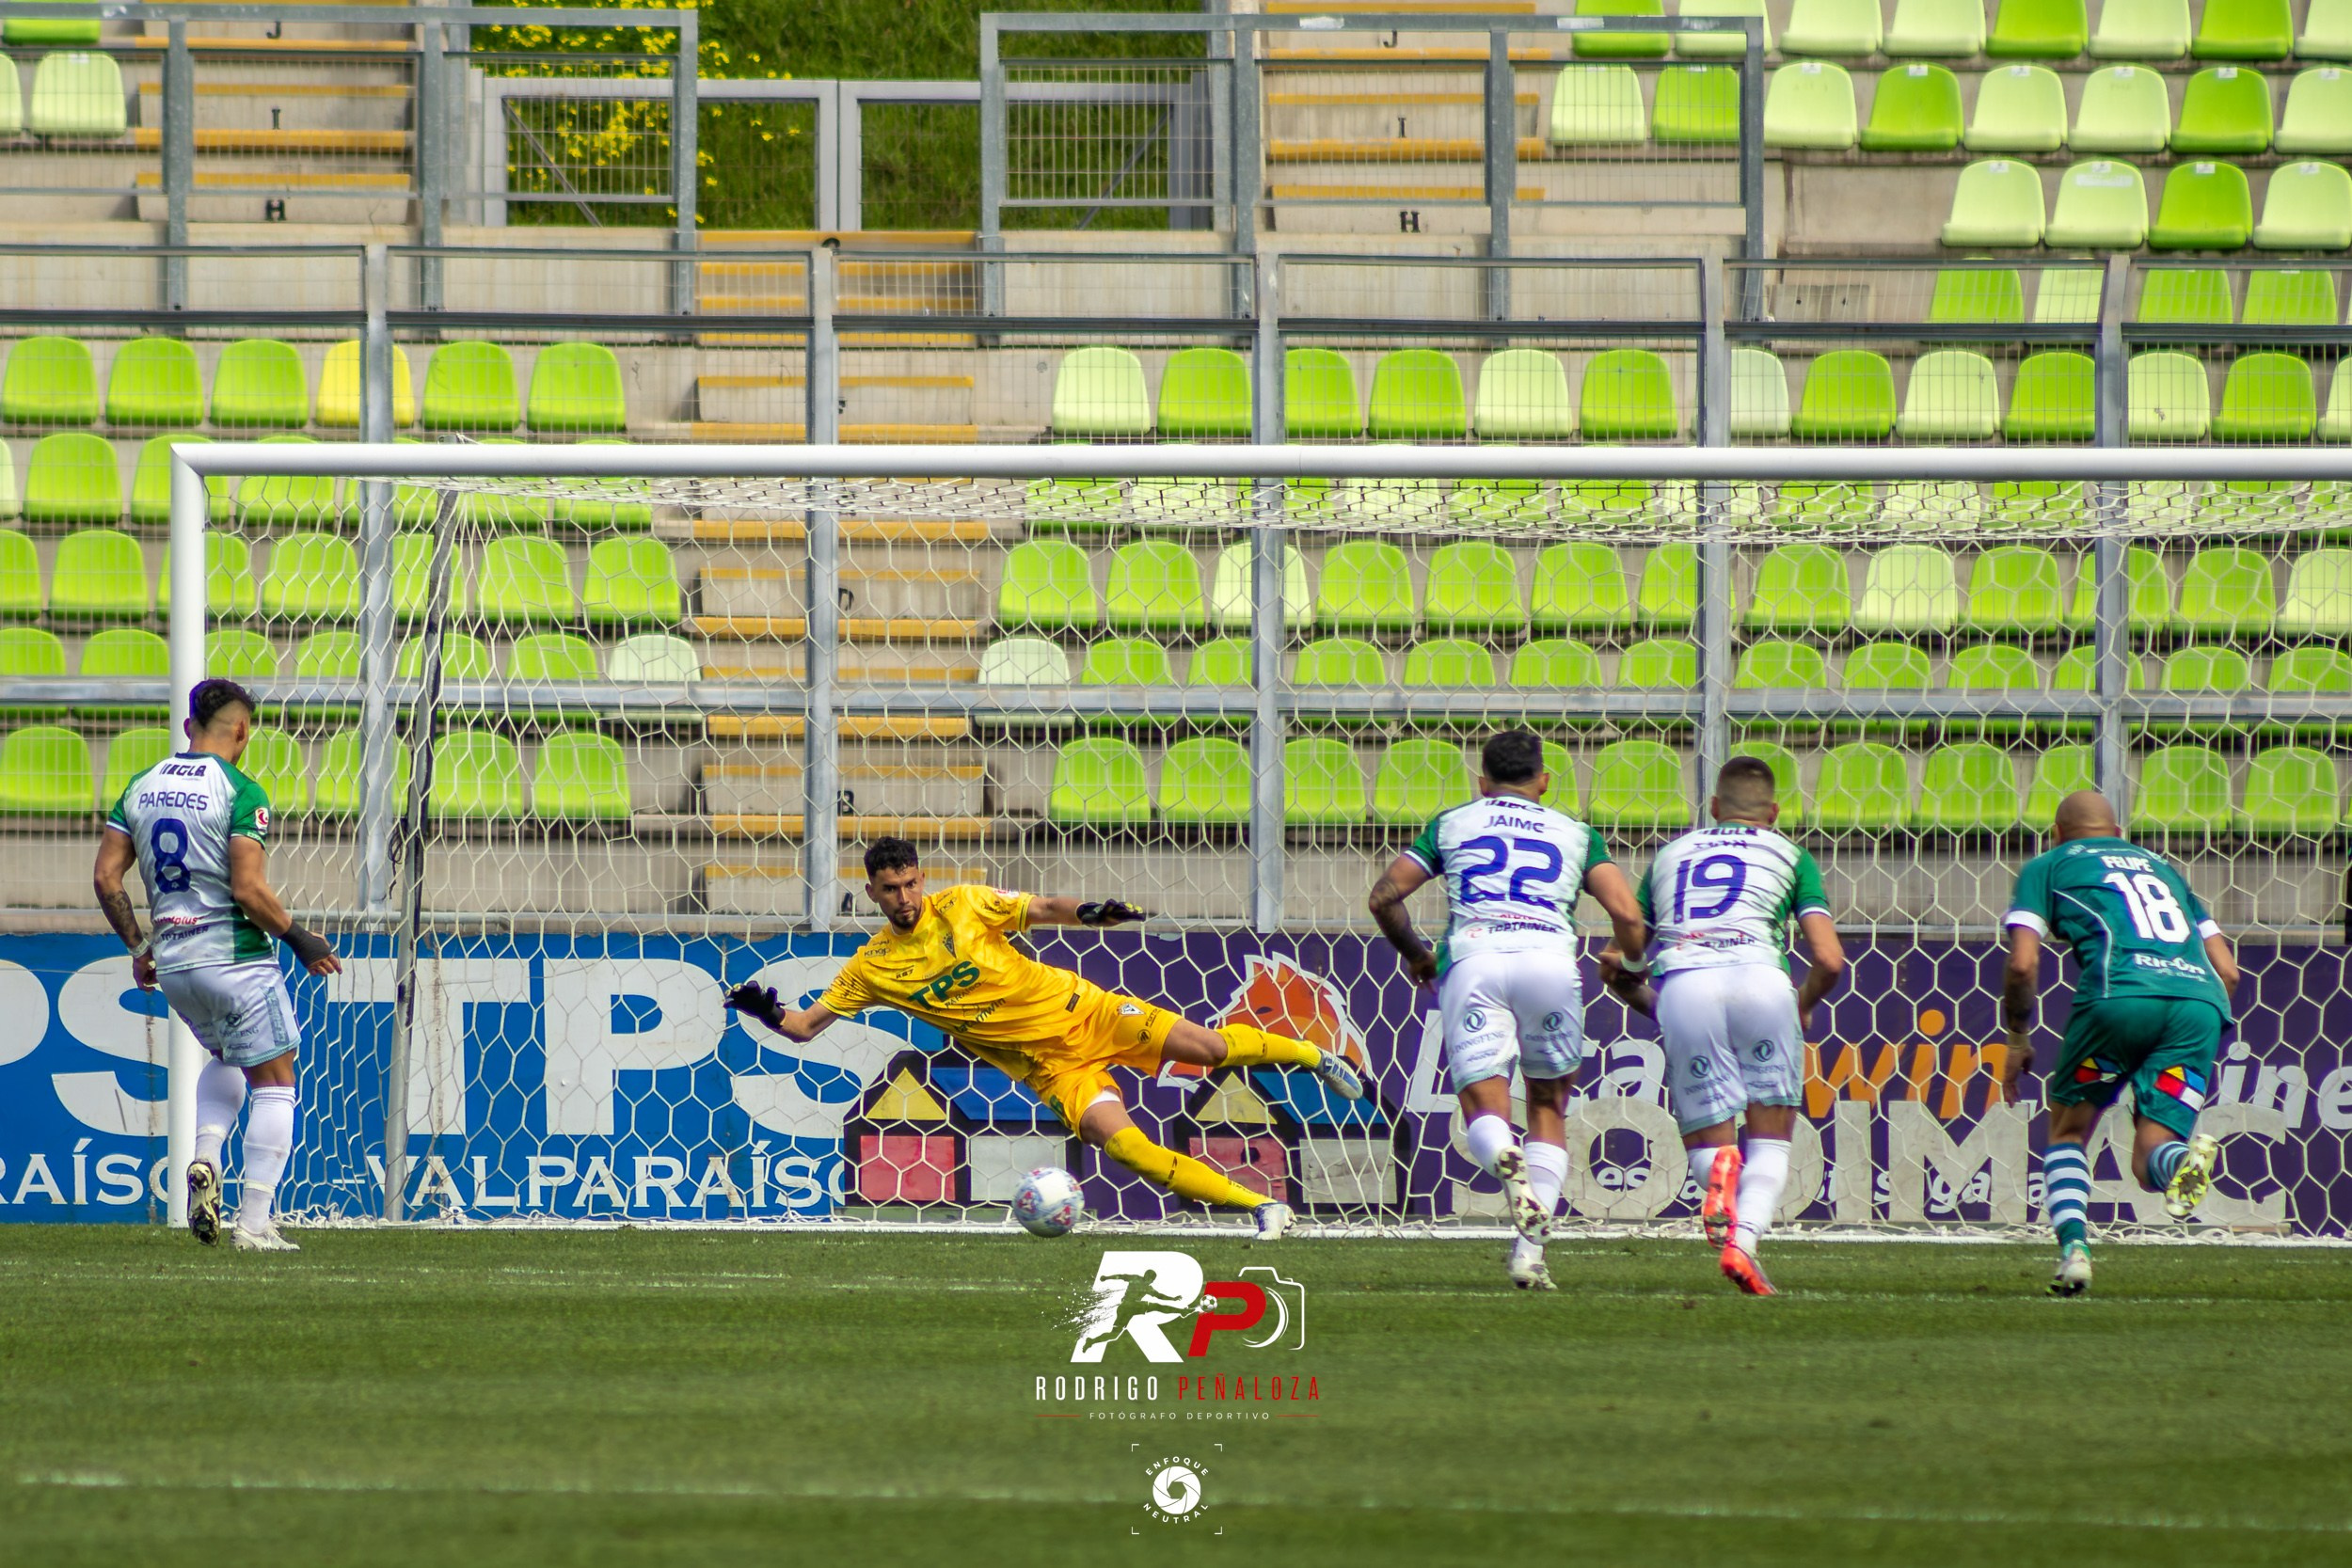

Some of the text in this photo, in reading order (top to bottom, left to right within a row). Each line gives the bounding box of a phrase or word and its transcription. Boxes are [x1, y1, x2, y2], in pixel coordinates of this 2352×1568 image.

[265, 198, 286, 221] H
[1399, 211, 1421, 233] H
[138, 791, 209, 811] PAREDES
[151, 817, 190, 895] 8
[1460, 835, 1563, 911] 22
[1673, 854, 1747, 925] 19
[2101, 855, 2154, 873] FELIPE
[2103, 872, 2191, 943] 18
[906, 960, 980, 1011] TPS
[327, 957, 920, 1139] TPS
[0, 1138, 169, 1207] AÍS
